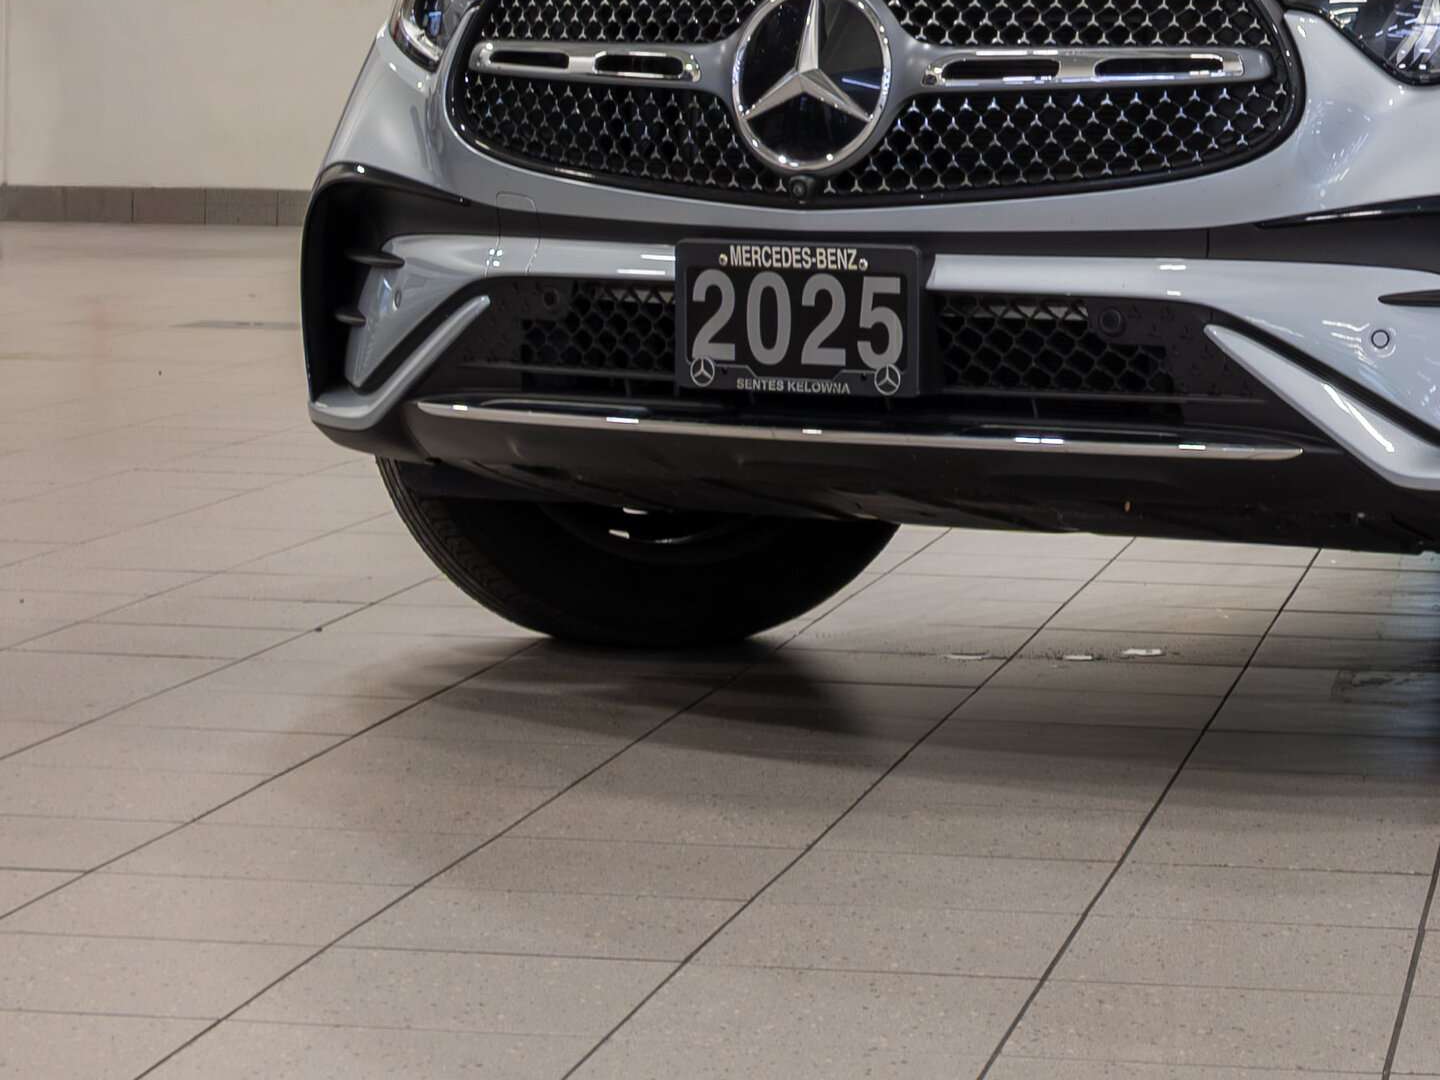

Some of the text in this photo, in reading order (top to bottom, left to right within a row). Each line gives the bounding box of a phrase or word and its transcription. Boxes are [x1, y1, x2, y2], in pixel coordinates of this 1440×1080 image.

[729, 245, 858, 270] MERCEDES-BENZ
[692, 269, 903, 369] 2025
[736, 378, 850, 395] SENTES KELOWNA
